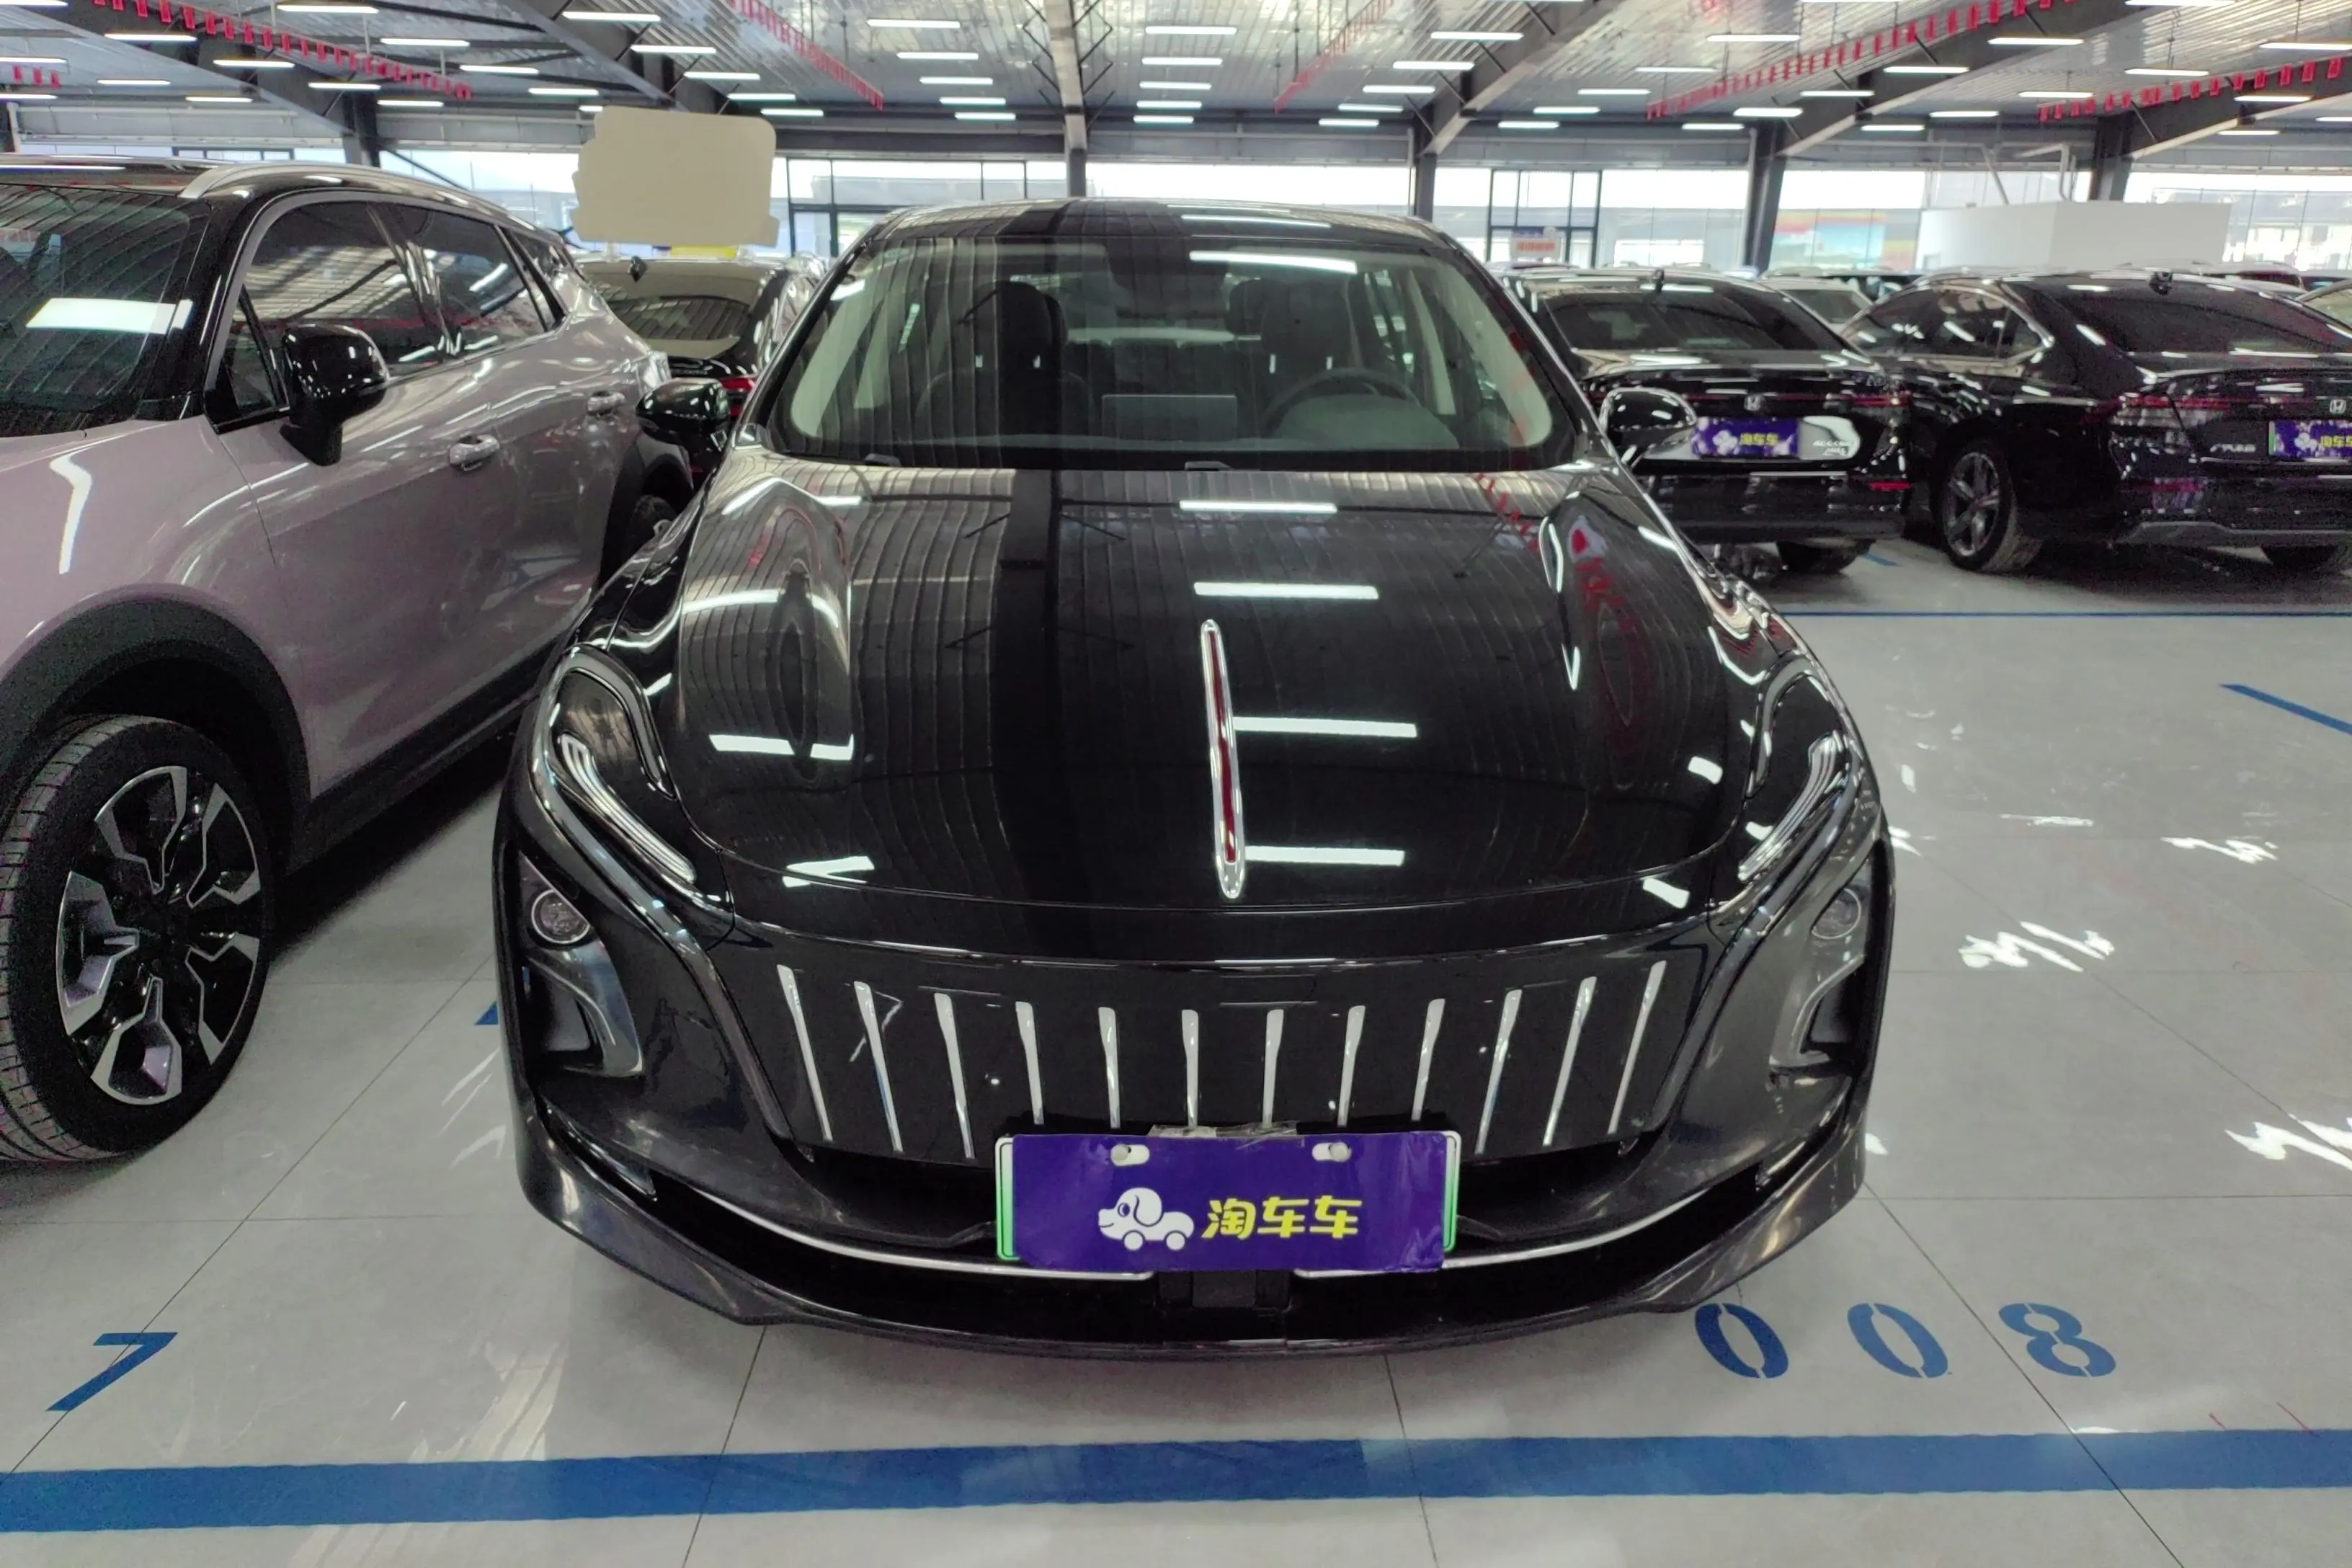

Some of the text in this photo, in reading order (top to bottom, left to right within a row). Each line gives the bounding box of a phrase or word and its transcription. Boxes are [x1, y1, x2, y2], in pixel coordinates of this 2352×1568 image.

[1201, 1195, 1362, 1240] 淘车车
[1695, 1303, 2116, 1378] 008
